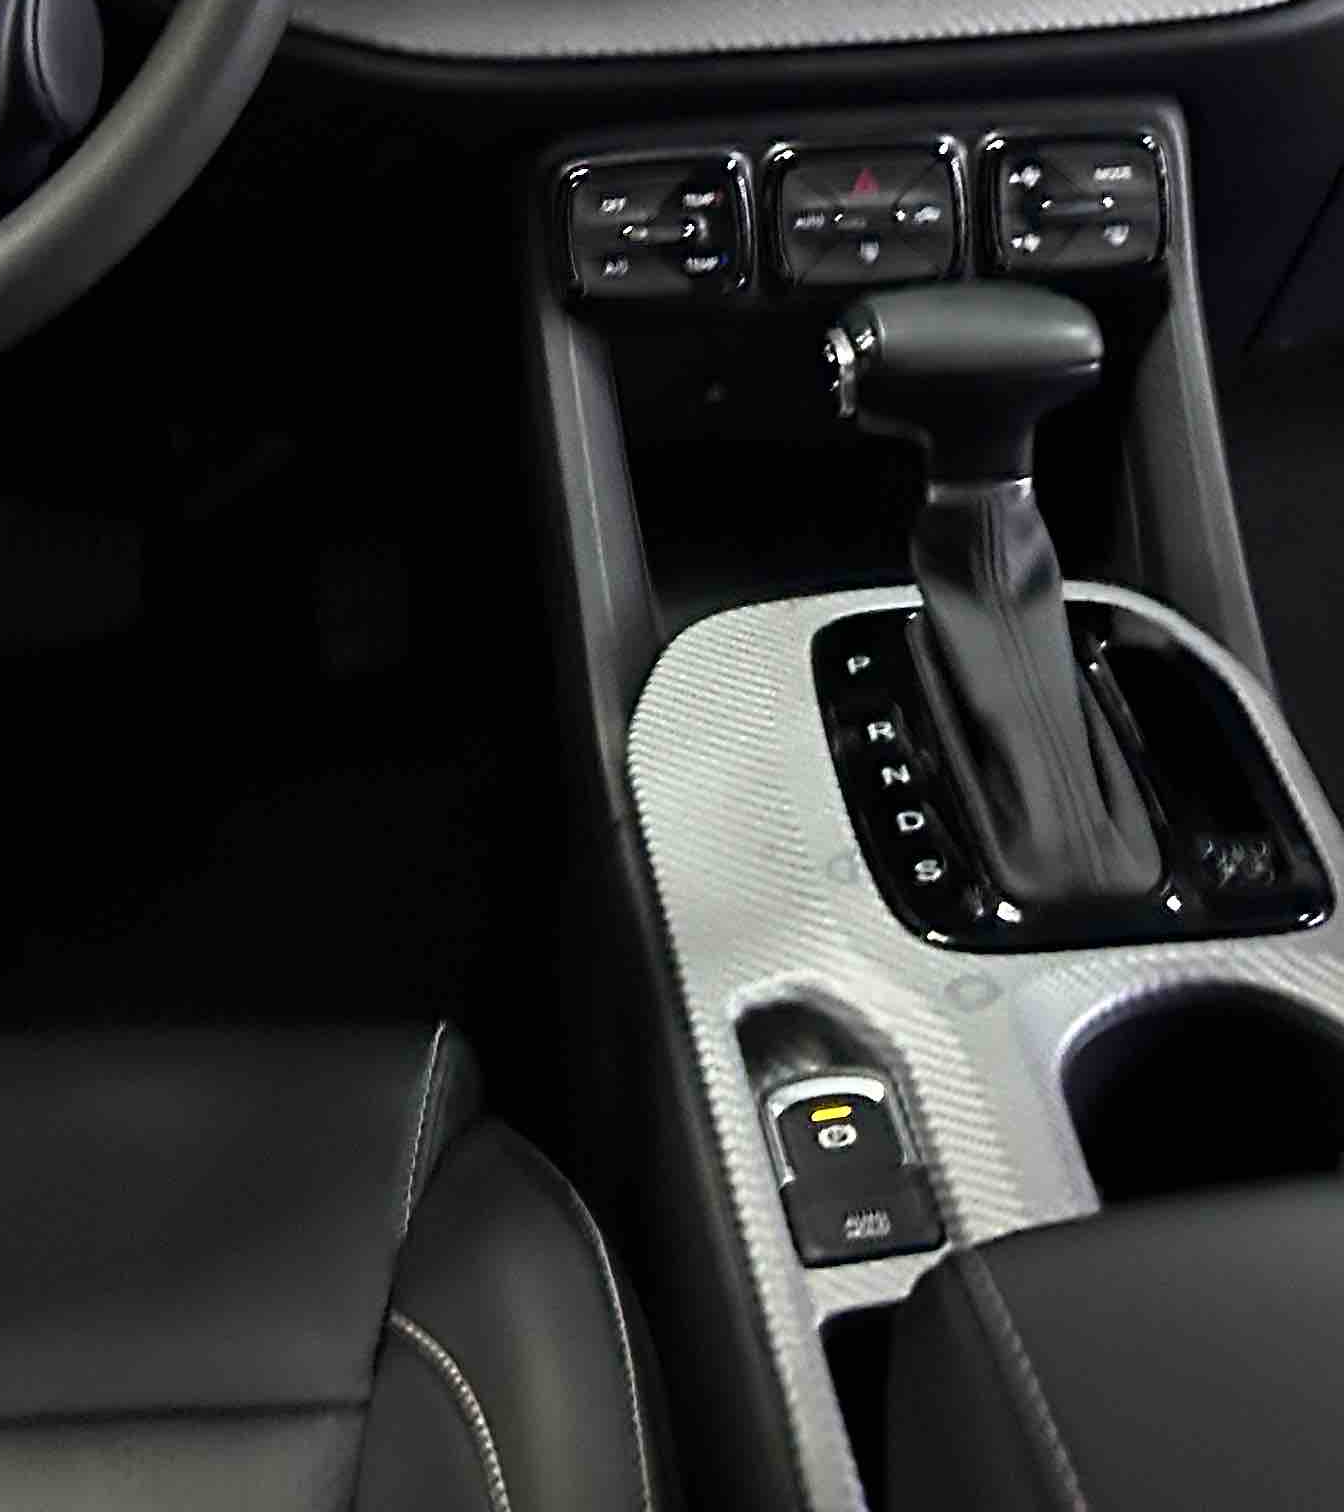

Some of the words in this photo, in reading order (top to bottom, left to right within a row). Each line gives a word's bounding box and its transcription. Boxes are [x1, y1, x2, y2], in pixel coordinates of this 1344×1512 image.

[847, 656, 871, 675] P
[867, 721, 895, 742] R
[881, 764, 911, 786] N
[896, 810, 925, 832] D
